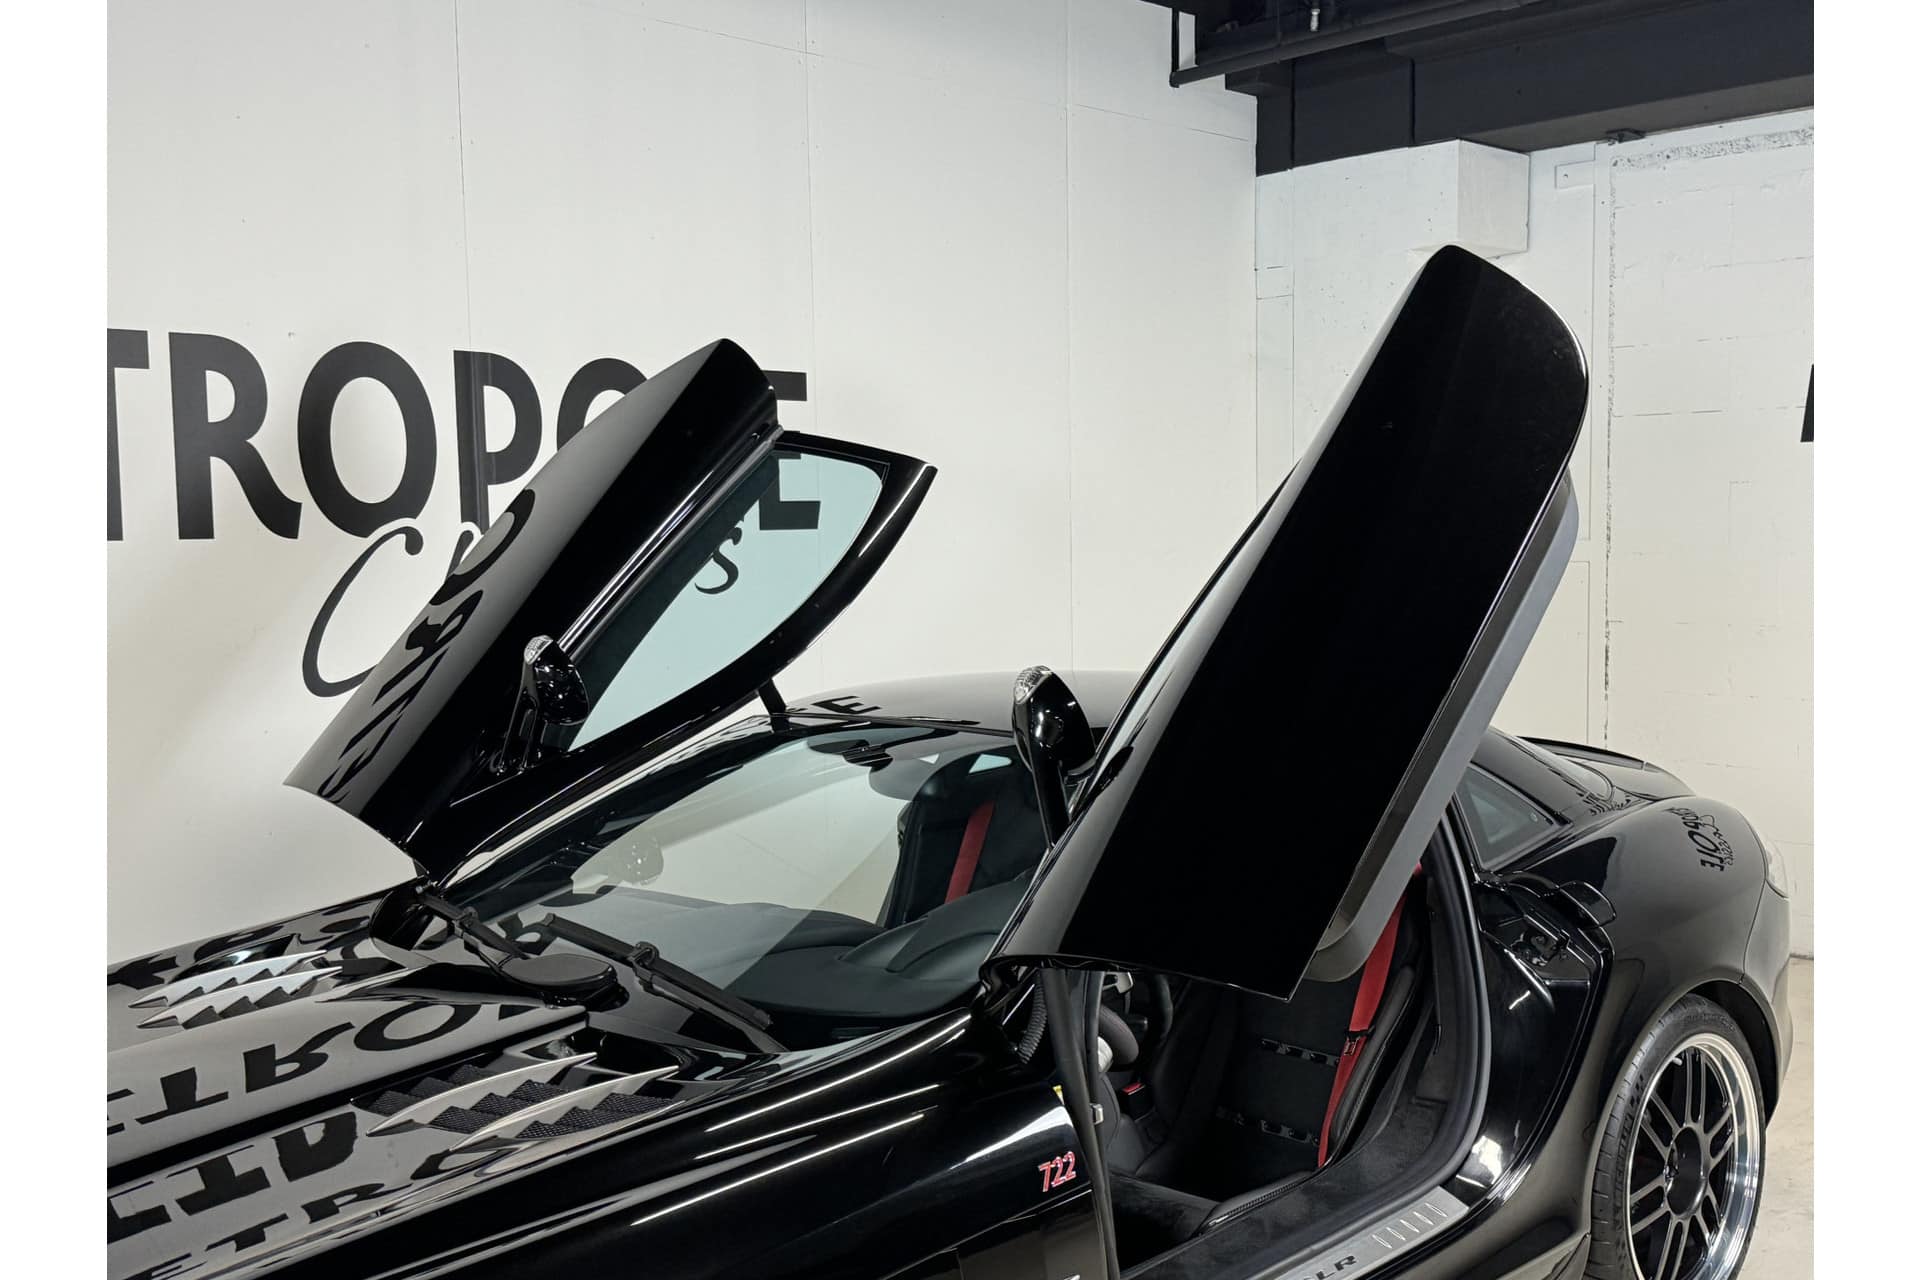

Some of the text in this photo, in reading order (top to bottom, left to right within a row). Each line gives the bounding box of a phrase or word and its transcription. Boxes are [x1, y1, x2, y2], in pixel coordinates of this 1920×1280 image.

[107, 327, 821, 541] ROPE
[1038, 1150, 1077, 1193] 722
[1303, 1255, 1357, 1280] LR
